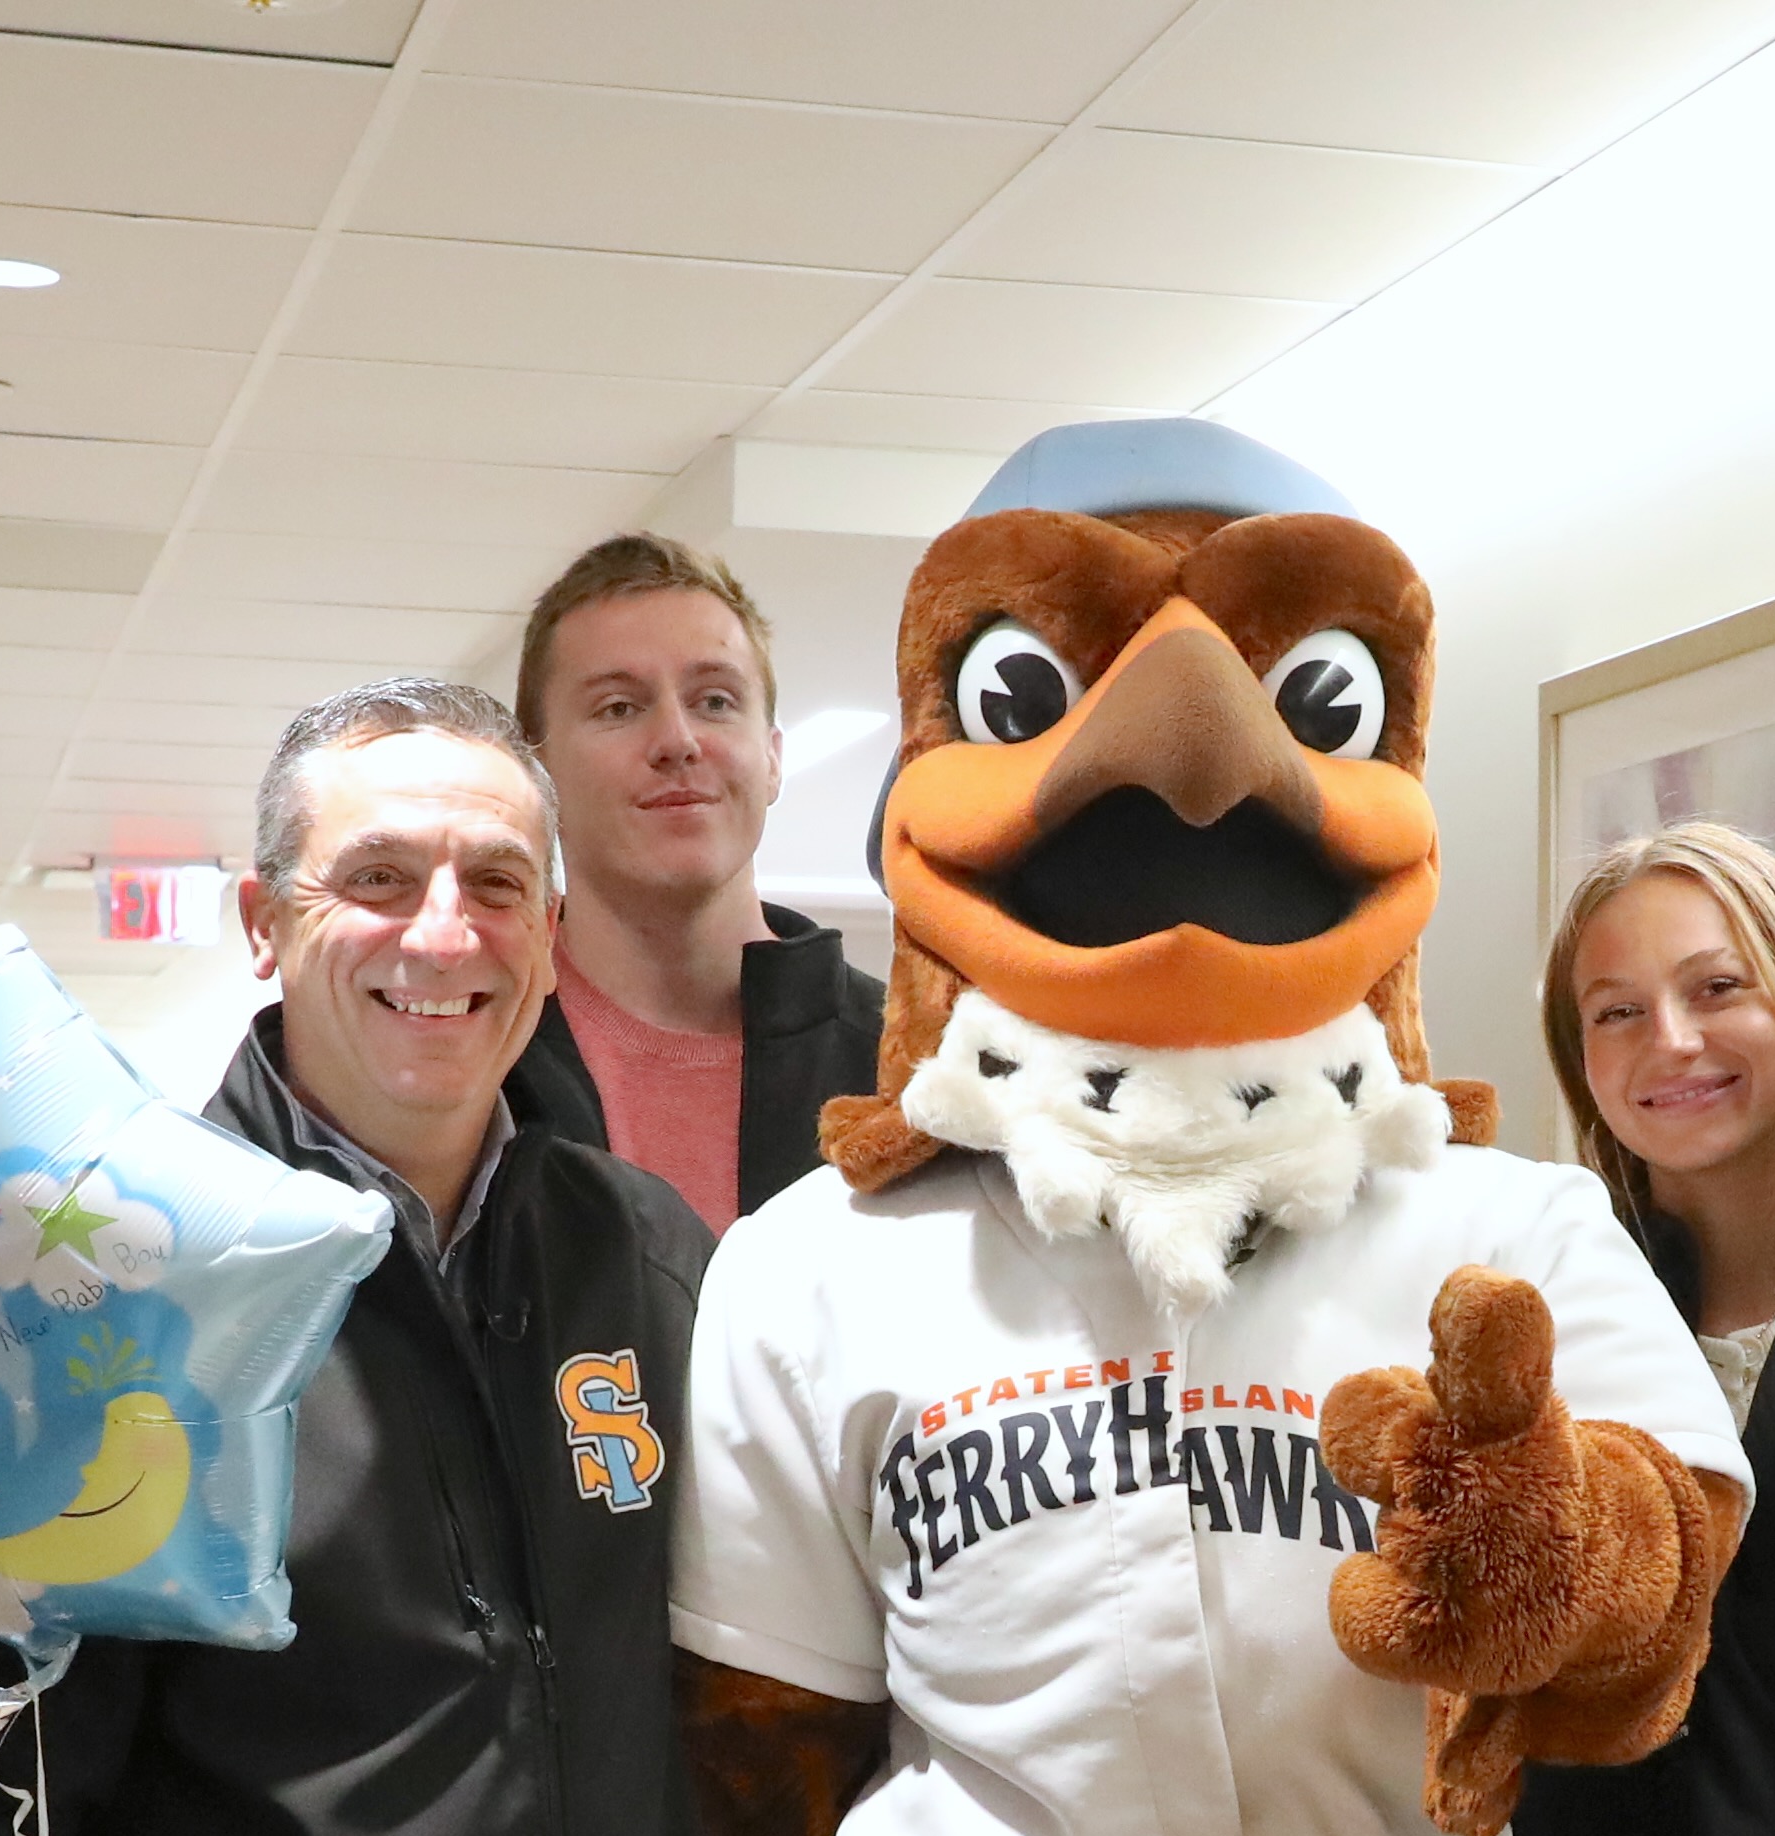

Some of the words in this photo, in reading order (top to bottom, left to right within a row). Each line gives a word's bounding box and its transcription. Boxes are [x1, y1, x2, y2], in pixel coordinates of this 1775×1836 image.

[50, 1278, 121, 1316] Baby
[919, 1356, 1132, 1438] STATEN
[1151, 1349, 1316, 1420] ISLAN
[879, 1375, 1380, 1600] FERRYHAWK
